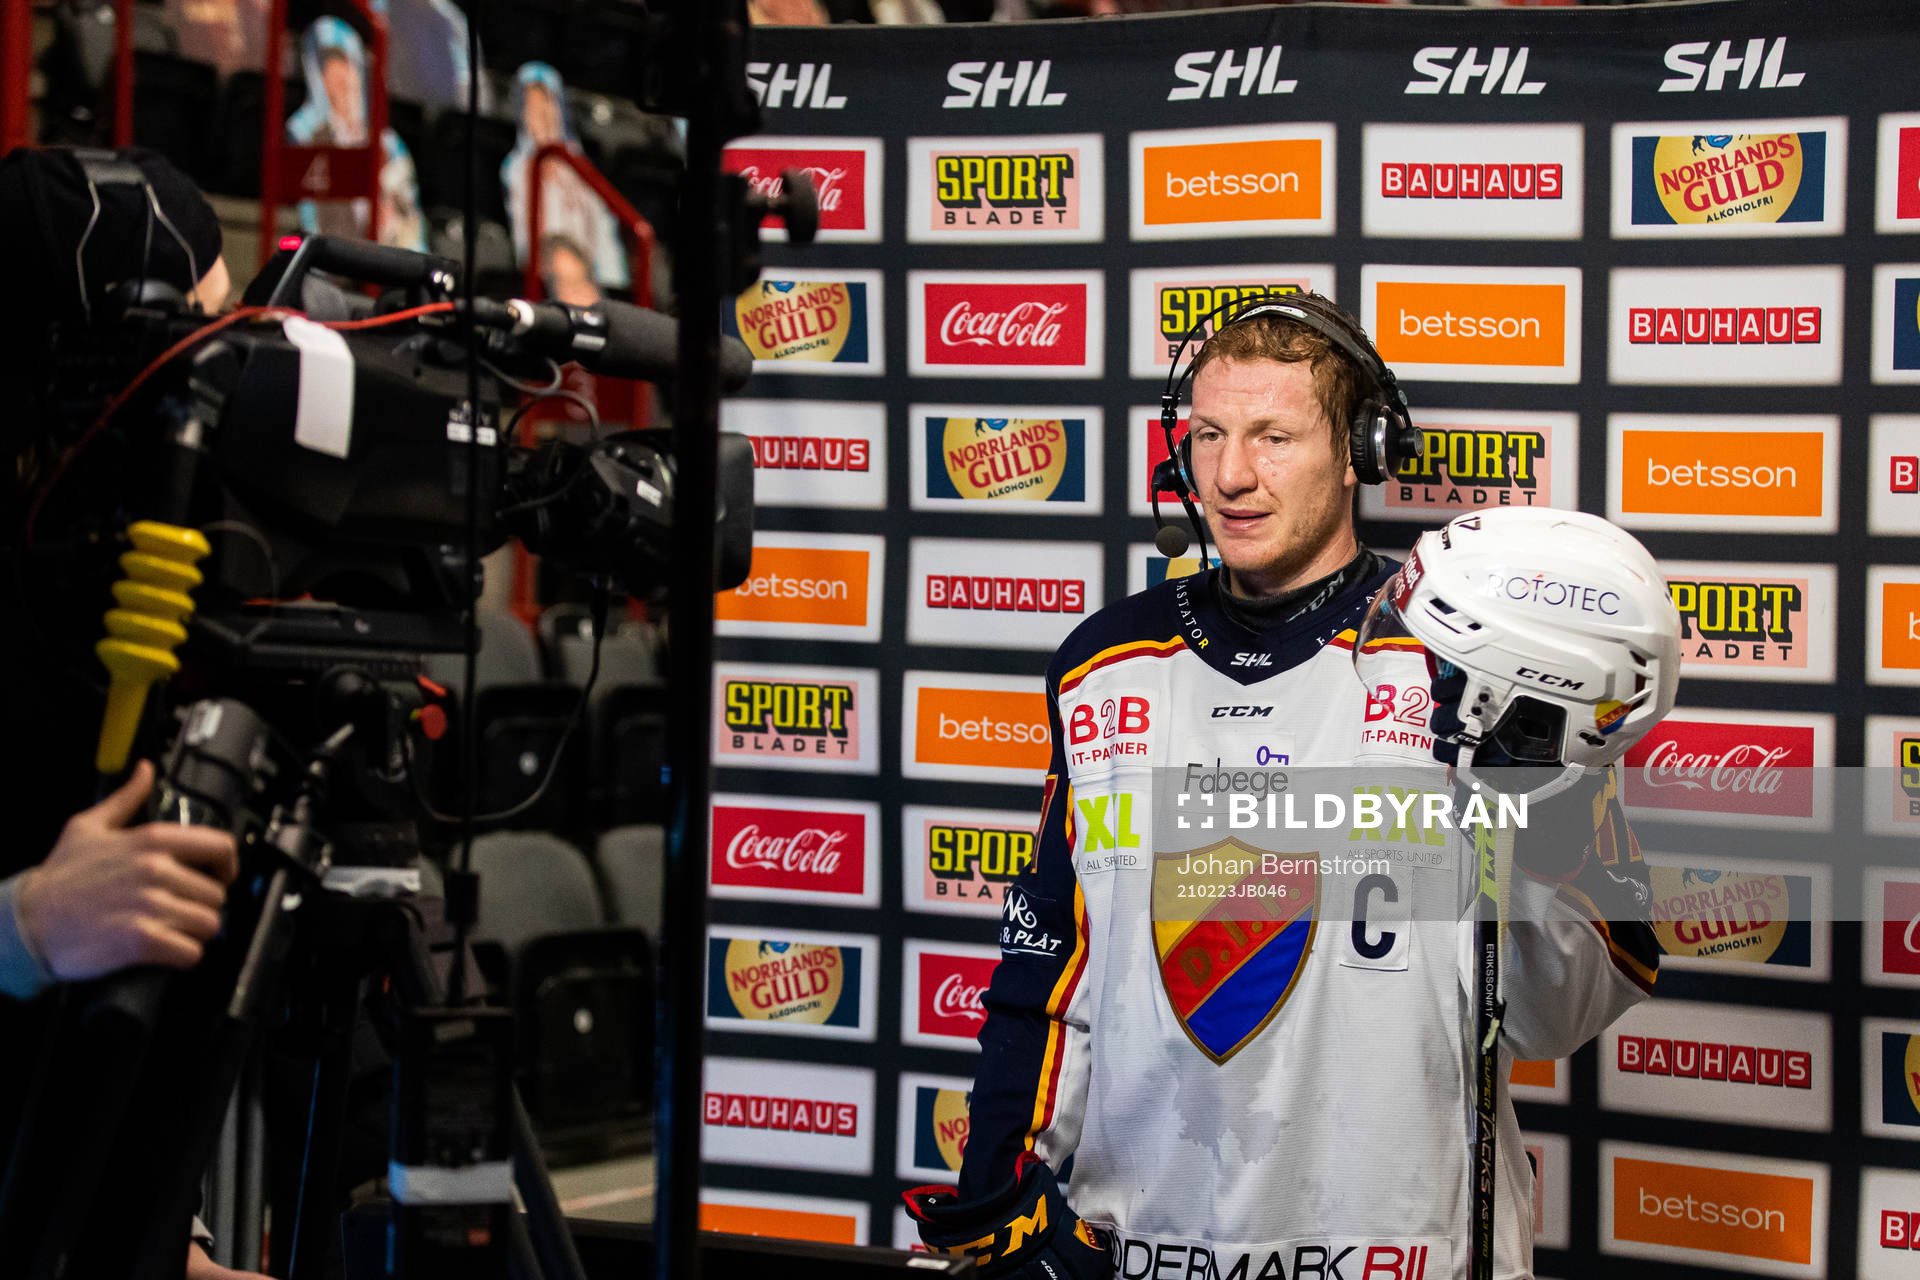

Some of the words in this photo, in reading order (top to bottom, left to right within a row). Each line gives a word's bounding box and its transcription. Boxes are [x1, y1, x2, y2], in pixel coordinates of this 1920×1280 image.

[942, 60, 1067, 108] SHL
[1167, 45, 1298, 101] SHL
[1404, 47, 1547, 94] SHL
[1657, 36, 1806, 92] SHL
[936, 153, 1074, 208] SPORT
[1167, 170, 1299, 198] betsson
[1383, 165, 1560, 196] BAUHAUS
[1659, 134, 1796, 195] NORRLANDS
[1682, 159, 1785, 213] GULD
[944, 210, 1067, 225] BLADET
[1706, 194, 1775, 223] ALKOHOLFRI
[741, 283, 846, 334] NORRLANDS
[757, 305, 838, 350] GULD
[940, 301, 1068, 347] Coca-Cola
[1400, 309, 1541, 339] betsson
[1631, 309, 1819, 342] BAUHAUS
[774, 338, 830, 360] ALKOHOLFRI
[750, 438, 868, 470] UHAUS
[948, 419, 1060, 473] NORRLANDS
[967, 443, 1053, 489] GULD
[987, 476, 1044, 500] ALKOHOLFRI
[1647, 458, 1797, 488] betsson
[1400, 486, 1537, 505] BLADET
[929, 577, 1082, 611] BAUHAUS
[1488, 573, 1620, 615] ROTOTEC
[1668, 582, 1801, 643] PORT
[1230, 652, 1273, 667] SHL
[1516, 666, 1585, 691] CCM
[725, 680, 853, 740] SPORT
[1070, 696, 1150, 745] B2B
[1211, 706, 1274, 718] CCM
[1364, 684, 1434, 728] B2
[733, 735, 848, 754] BLADET
[939, 713, 1052, 744] betsso
[1362, 730, 1433, 750] IT-PARTN
[1184, 758, 1288, 802] Fabege
[1643, 740, 1793, 795] Coca-Cola
[726, 824, 849, 875] Coca-Cola
[929, 826, 1038, 882] SPOR
[1407, 851, 1443, 865] UNITED
[1351, 873, 1399, 959] C
[1652, 876, 1782, 926] NORRLANDS
[1674, 900, 1772, 945] GULD
[1013, 929, 1062, 951] PLÅT
[1697, 935, 1763, 958] ALKOHOLFRI
[731, 945, 838, 992] NORRLANDS
[748, 969, 830, 1012] GULD
[1620, 1038, 1809, 1086] BAUHAUS
[705, 1095, 856, 1134] BAUHAUS
[1639, 1186, 1785, 1233] betsson
